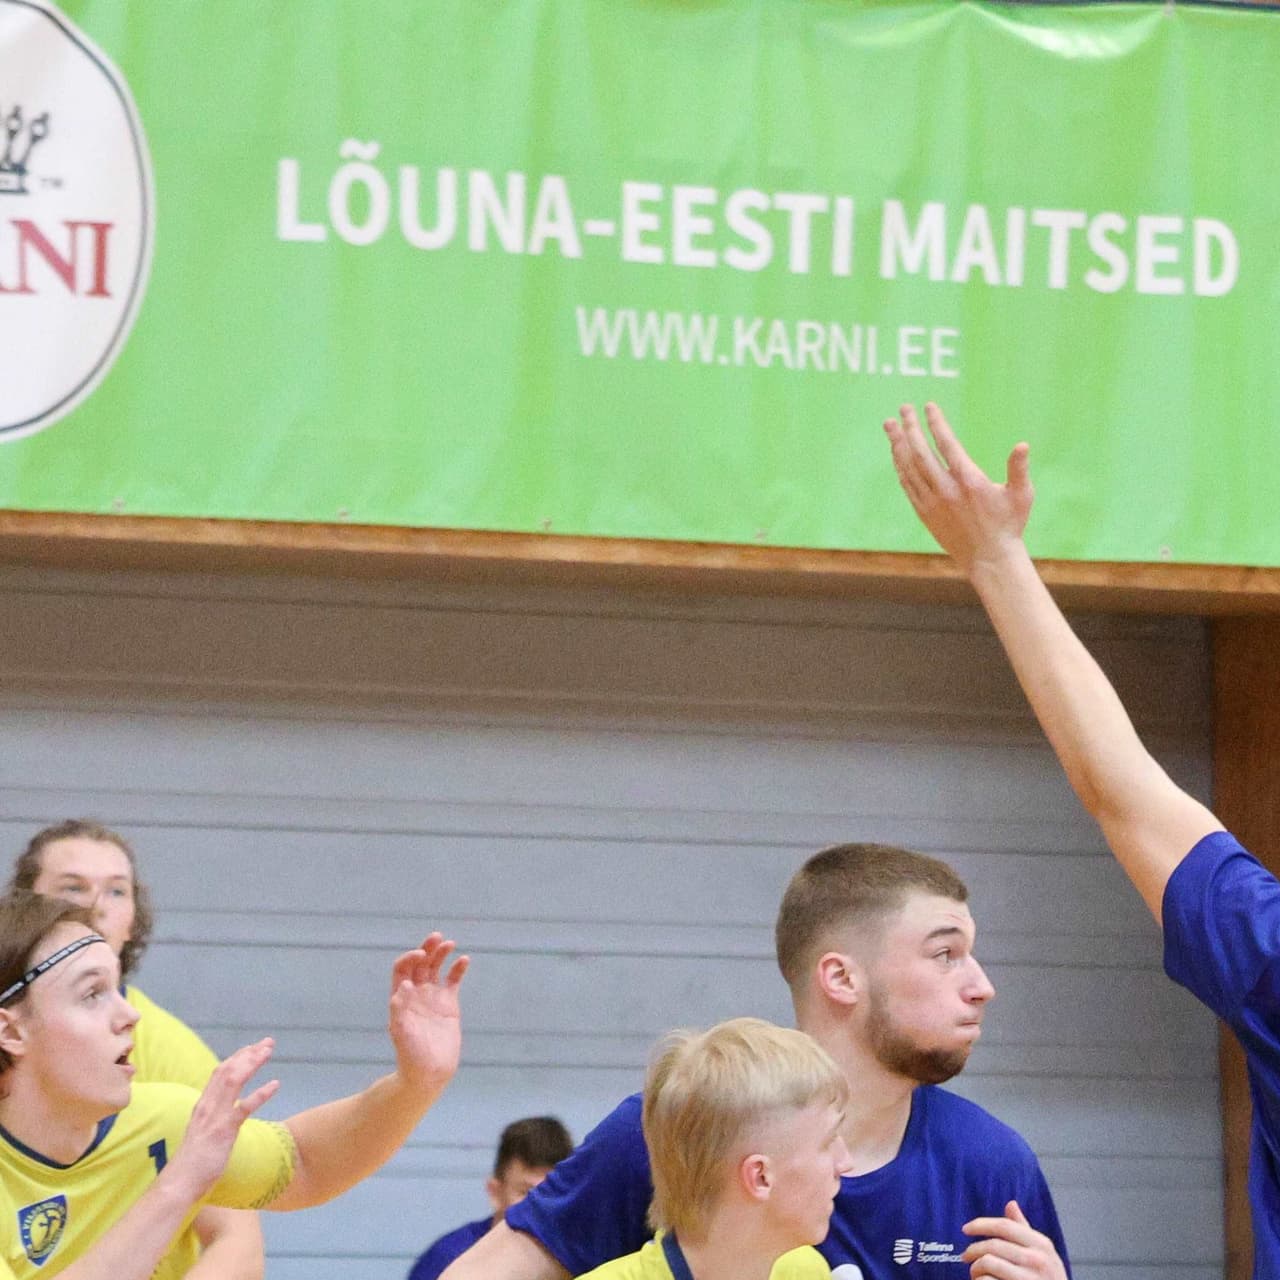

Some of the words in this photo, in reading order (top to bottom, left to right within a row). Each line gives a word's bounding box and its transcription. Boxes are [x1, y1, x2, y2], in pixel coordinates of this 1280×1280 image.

[0, 218, 114, 298] NI
[277, 138, 854, 277] LÕUNA-EESTI
[880, 200, 1241, 298] MAITSED
[576, 306, 961, 379] WWW.KARNI.EE
